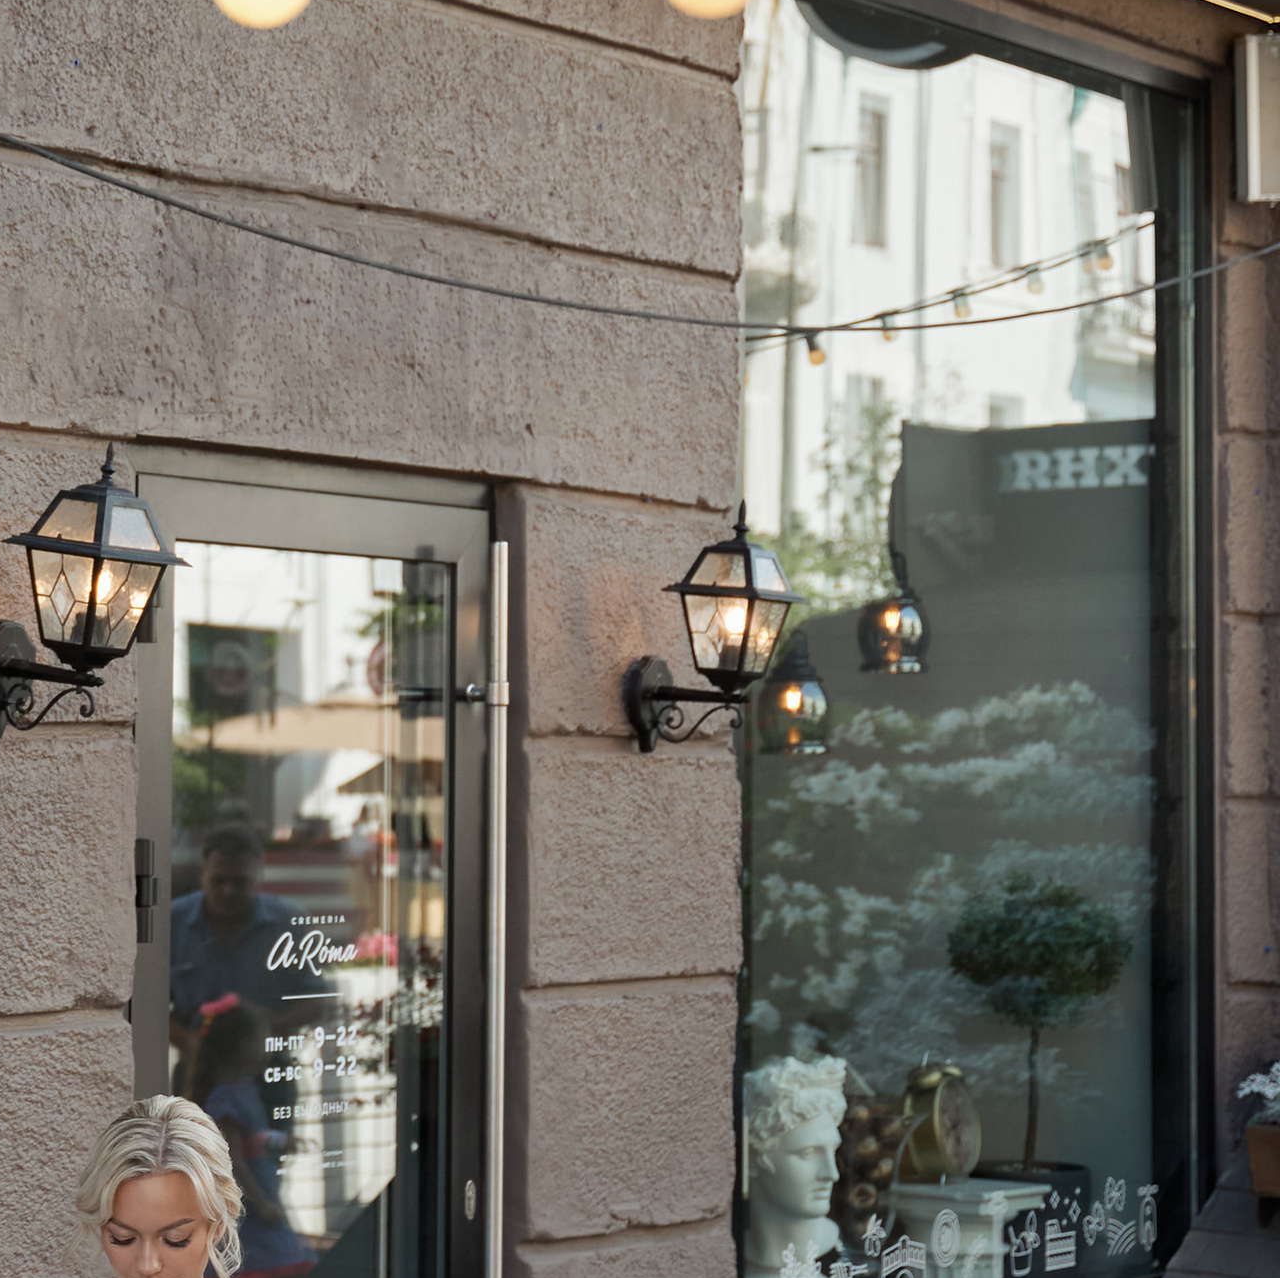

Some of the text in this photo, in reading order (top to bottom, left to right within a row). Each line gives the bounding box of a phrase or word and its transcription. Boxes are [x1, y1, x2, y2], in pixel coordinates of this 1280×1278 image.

[291, 915, 346, 926] CREMERIA
[264, 1035, 305, 1053] ПН-ПТ
[264, 1065, 303, 1083] СБ-ВС
[273, 1100, 349, 1120] БЕЗ ВЫОДНЫХ
